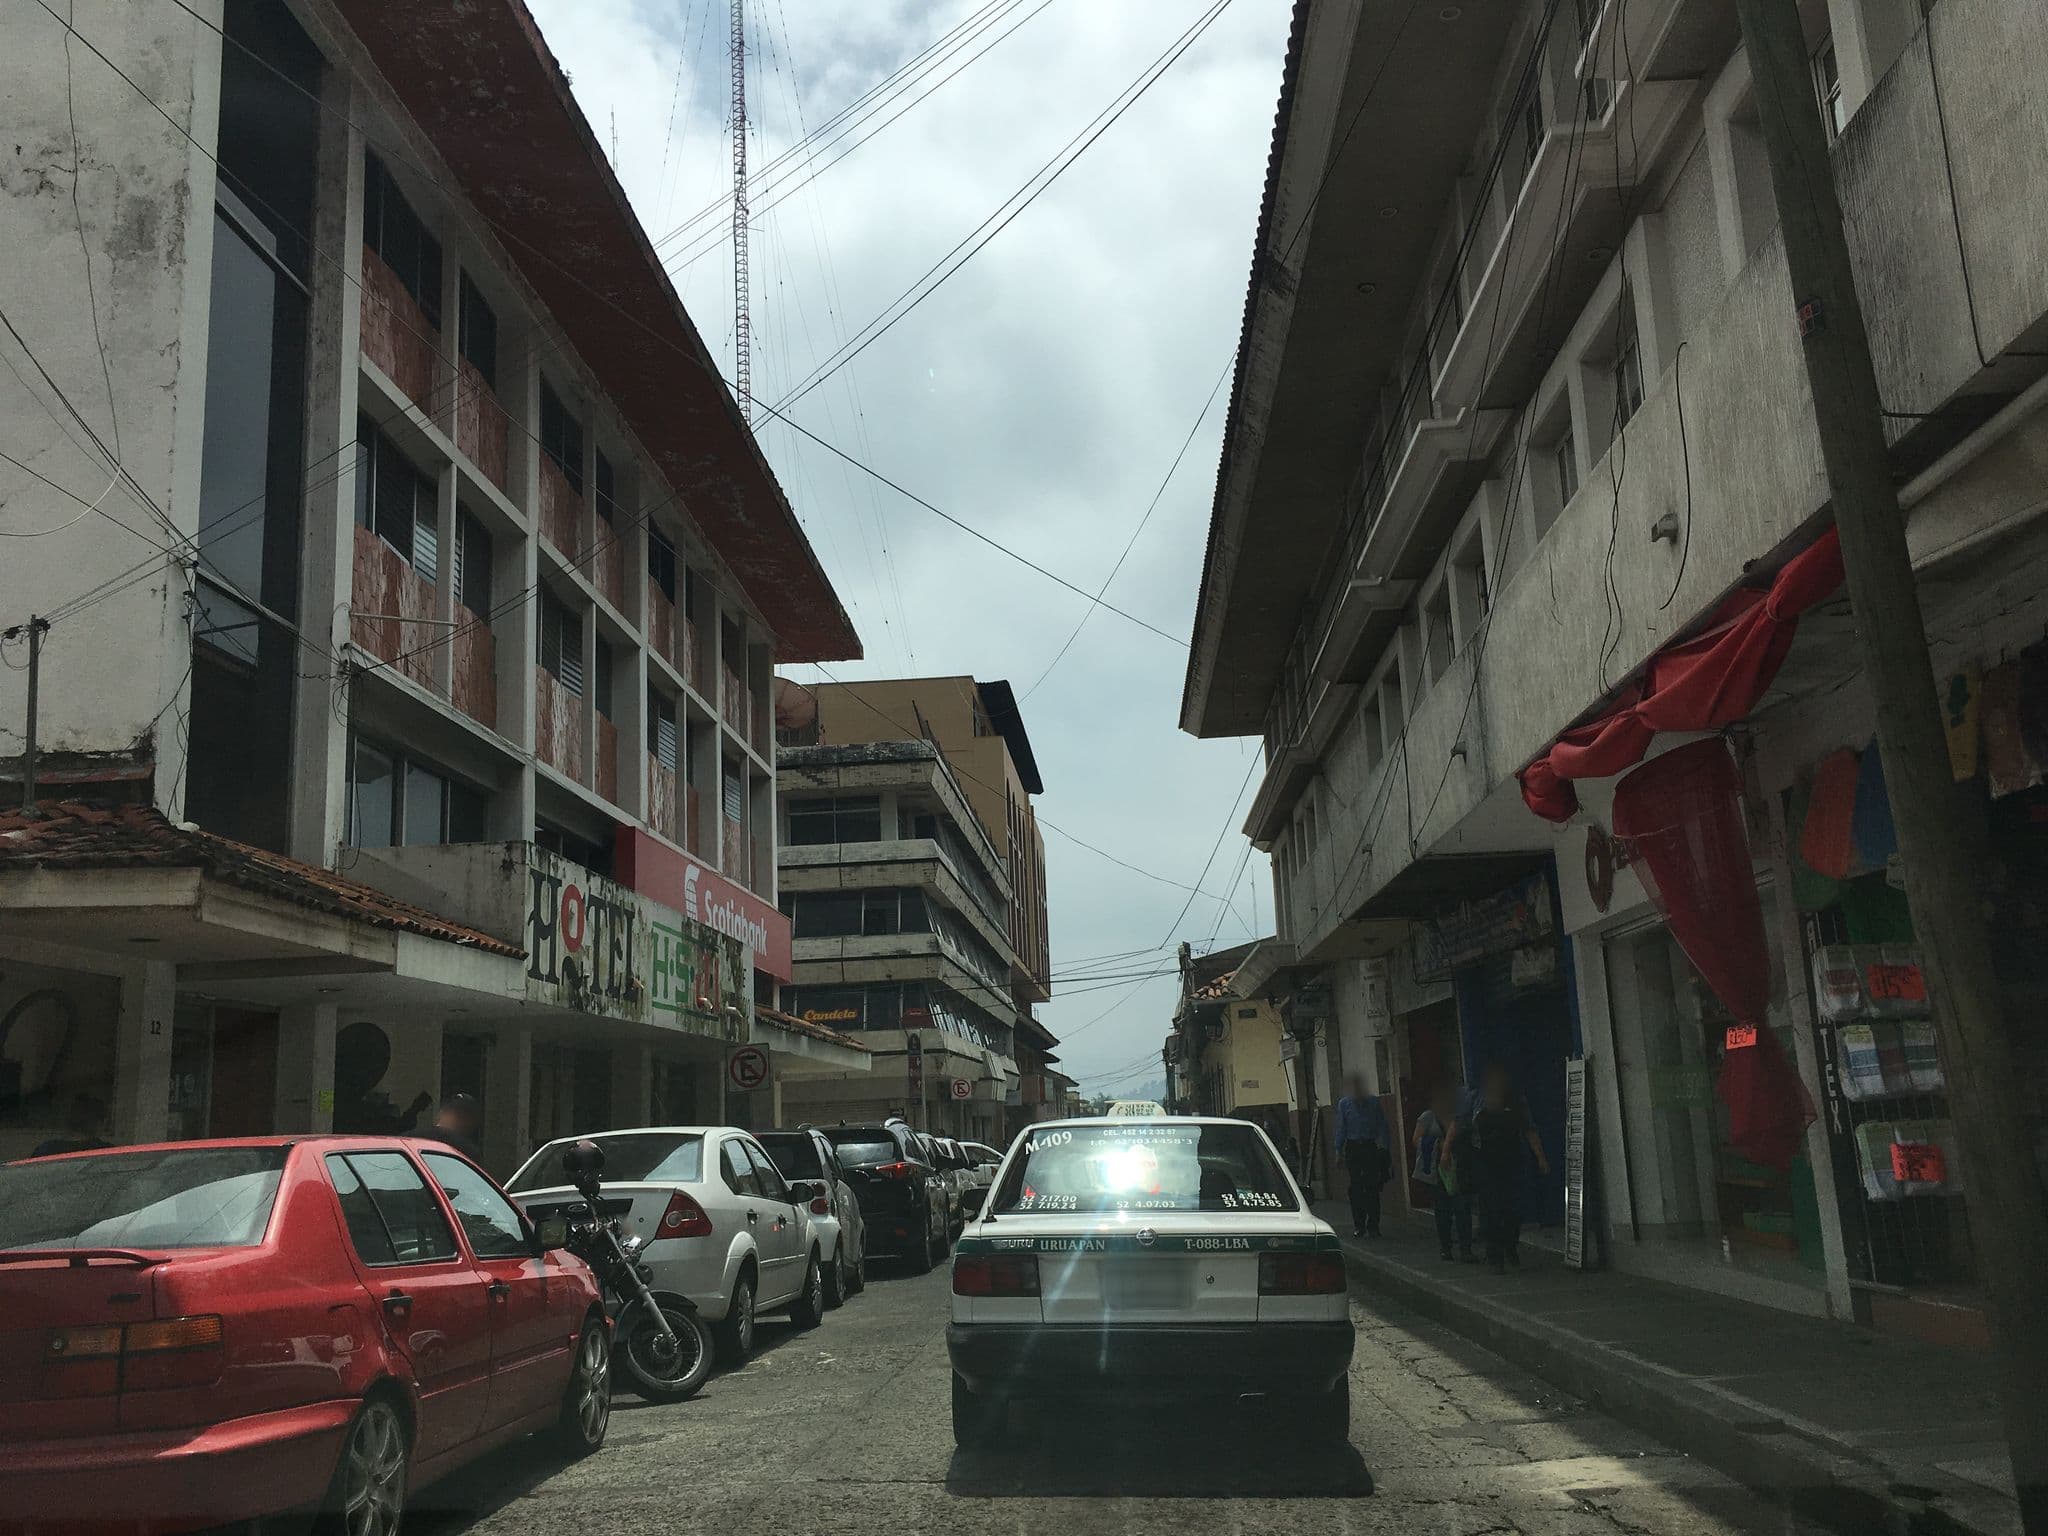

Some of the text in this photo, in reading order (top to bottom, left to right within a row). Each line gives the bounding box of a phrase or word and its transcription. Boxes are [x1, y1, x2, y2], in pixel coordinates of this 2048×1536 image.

[704, 889, 768, 957] Scotiabank
[804, 1009, 858, 1020] Candela
[151, 1020, 161, 1035] 12
[1024, 1131, 1073, 1155] M-109
[1040, 1194, 1077, 1202] 7.17.00
[1238, 1192, 1278, 1200] 4.94.84
[1019, 1201, 1077, 1210] 52 7.19.24
[1116, 1200, 1176, 1208] 52 4.07.03
[1224, 1199, 1282, 1208] 52 4.75.85
[1040, 1239, 1105, 1250] URUAPAN
[1184, 1238, 1250, 1250] T-088-LBA
